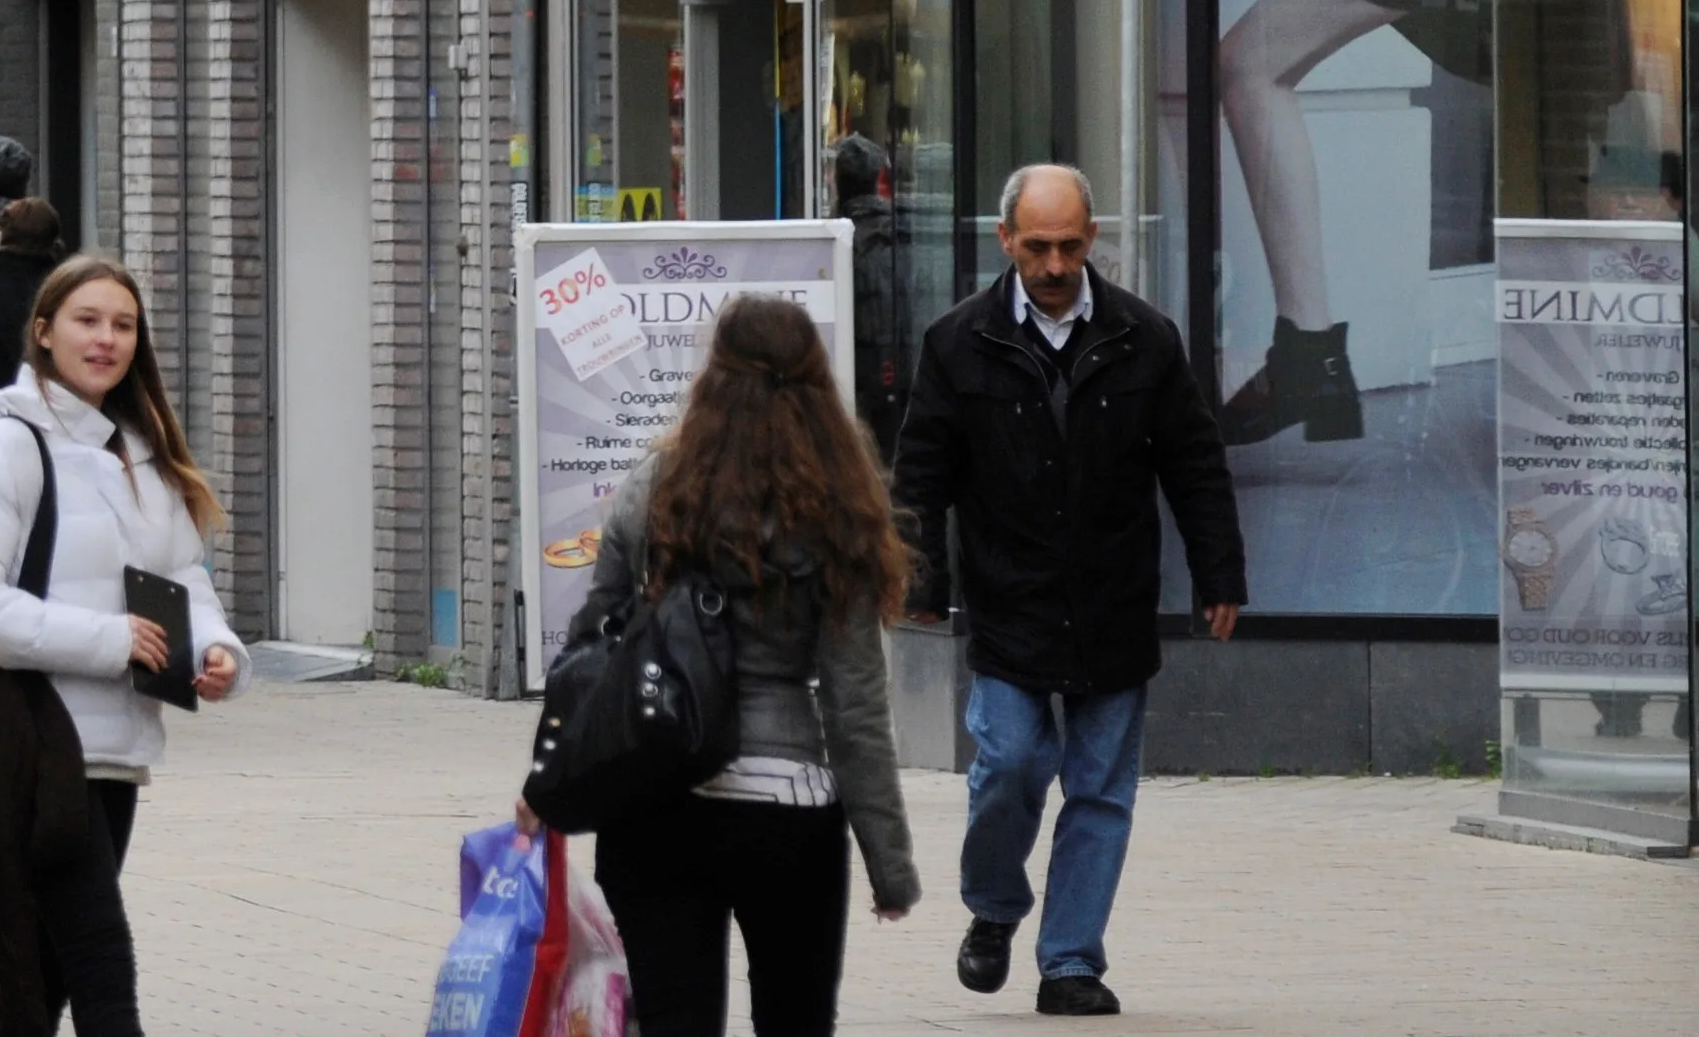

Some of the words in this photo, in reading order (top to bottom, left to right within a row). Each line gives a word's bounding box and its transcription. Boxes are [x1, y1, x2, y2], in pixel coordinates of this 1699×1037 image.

[539, 262, 606, 315] 30%
[561, 314, 608, 346] KORTING
[609, 304, 626, 319] OP
[592, 333, 613, 348] ALLE
[586, 436, 632, 450] Ruime
[551, 459, 607, 475] Horloge
